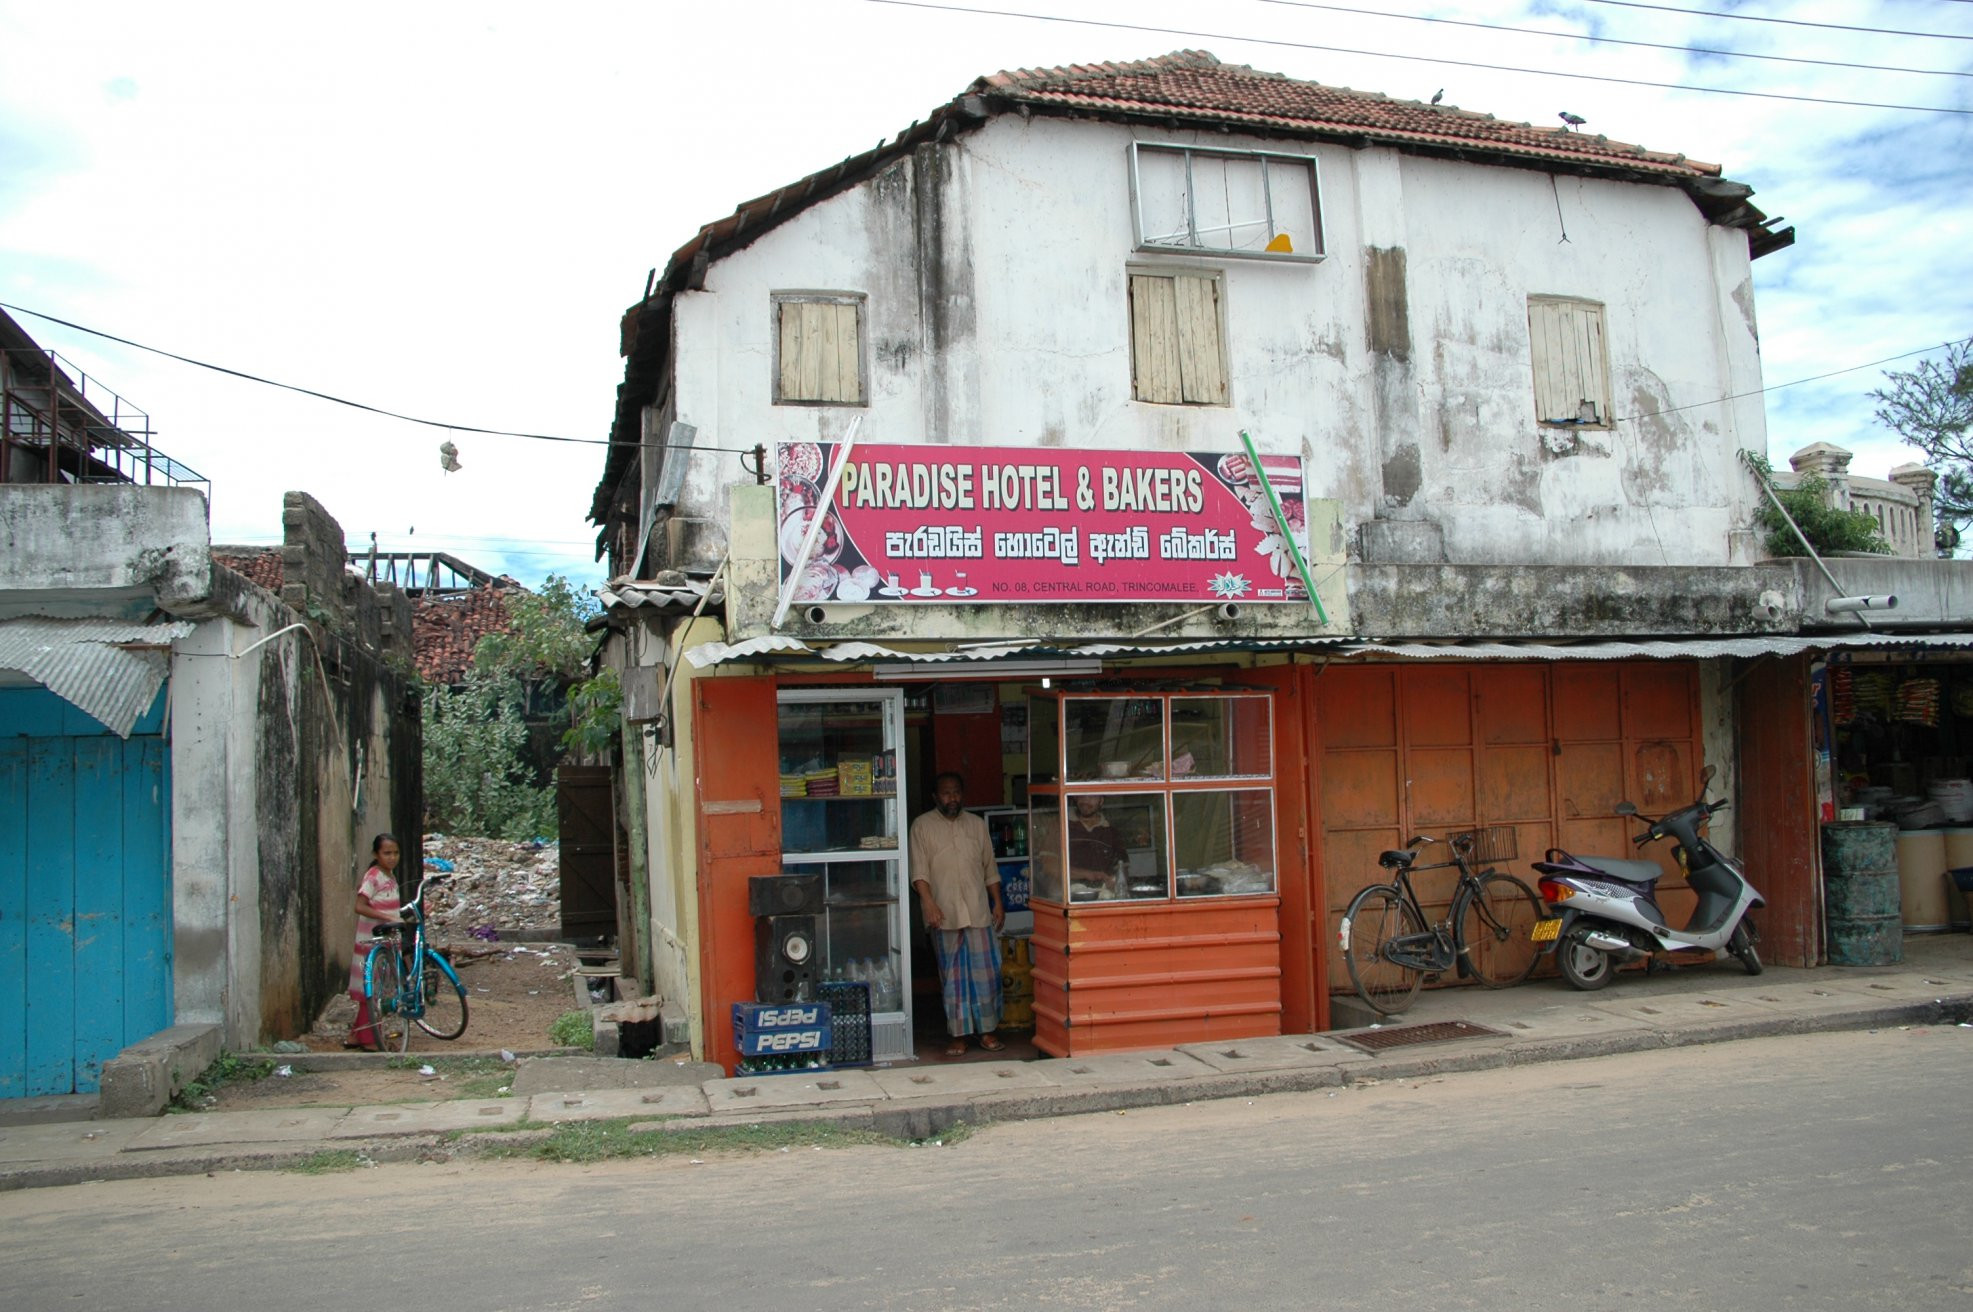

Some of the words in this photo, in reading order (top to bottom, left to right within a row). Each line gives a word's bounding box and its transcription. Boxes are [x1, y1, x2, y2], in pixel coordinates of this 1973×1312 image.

[842, 462, 974, 511] PARADISE
[981, 464, 1068, 511] HOTEL
[1076, 465, 1095, 511] &
[1102, 467, 1204, 513] BAKERS
[992, 581, 1012, 593] NO.
[1014, 581, 1030, 594] 08,
[1033, 581, 1083, 593] CENTRAL
[1086, 581, 1119, 594] ROAD,
[1122, 582, 1200, 594] TRINCOMALEE.
[757, 1007, 818, 1028] PEPSI
[756, 1030, 821, 1052] PEPSI
